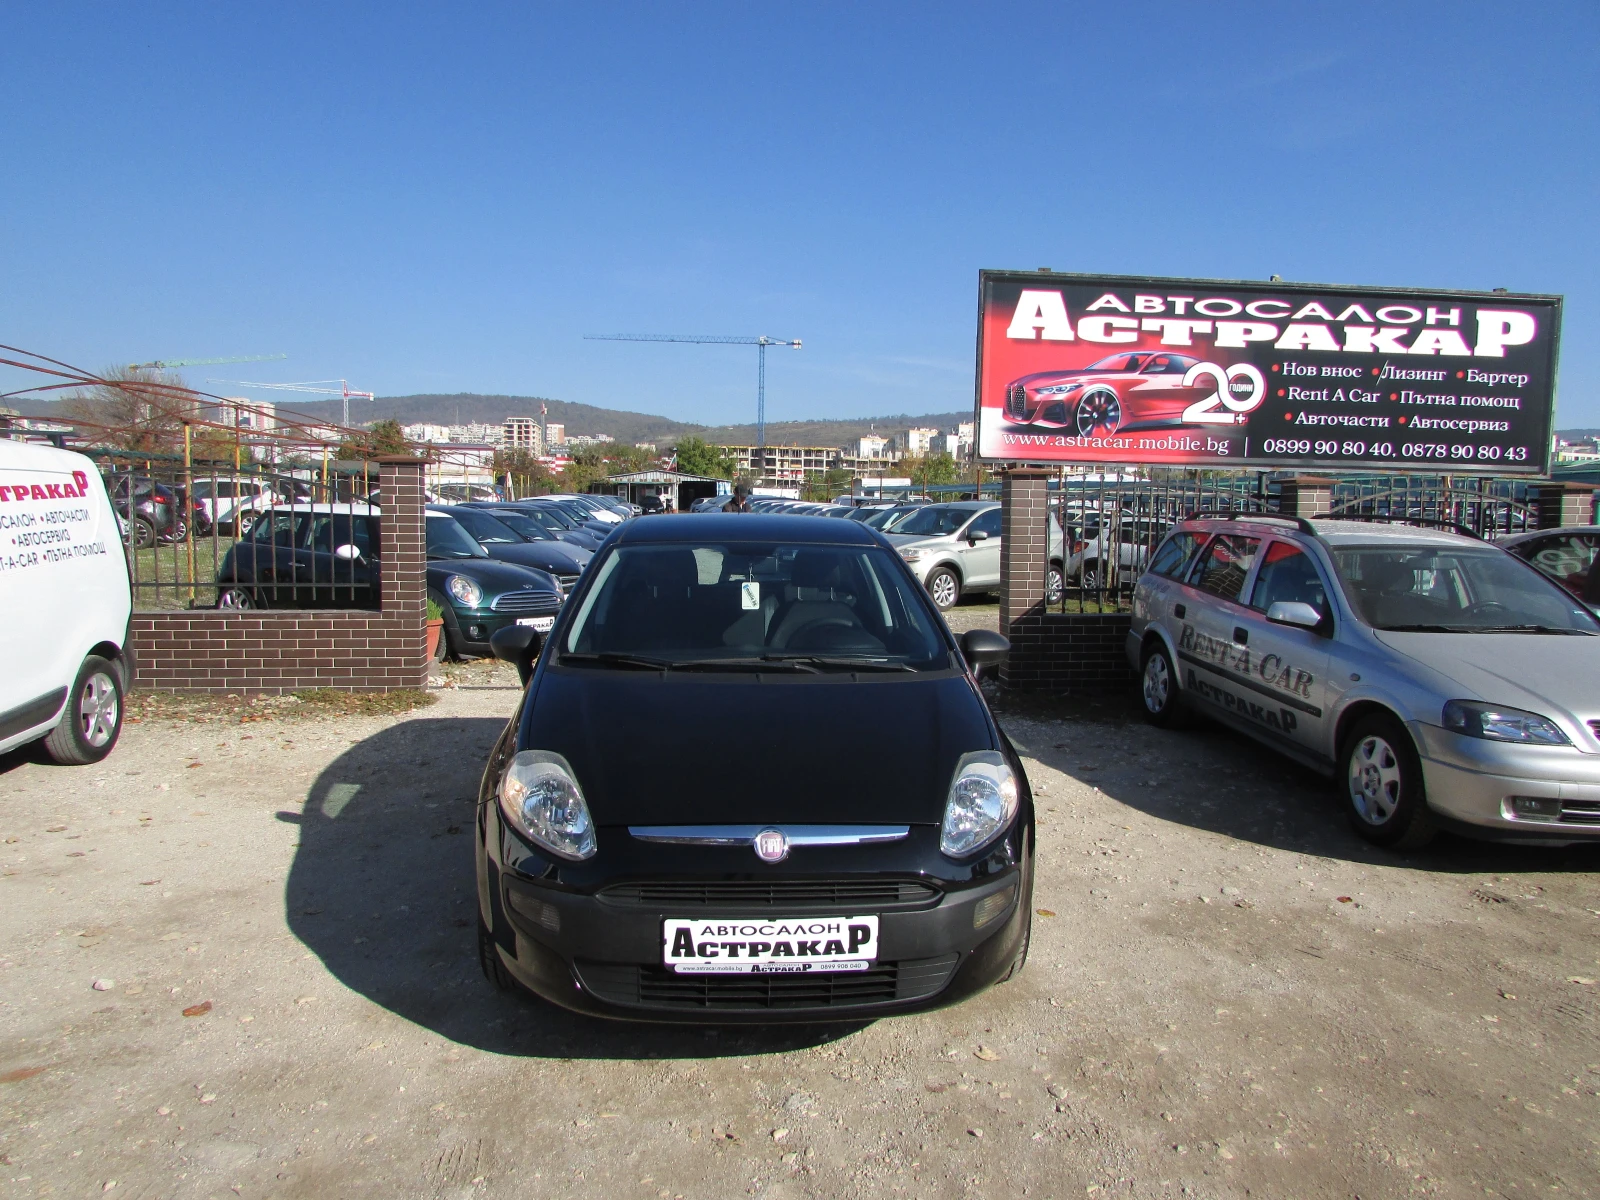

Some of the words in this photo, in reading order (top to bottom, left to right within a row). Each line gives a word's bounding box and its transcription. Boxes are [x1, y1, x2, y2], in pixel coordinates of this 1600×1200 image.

[1085, 294, 1461, 326] АВТОСАЛОН
[1006, 289, 1536, 357] АСТРАКАР
[1282, 363, 1317, 377] Нов
[1320, 366, 1362, 378] внос
[1379, 364, 1447, 383] Лизинг
[1466, 369, 1529, 388] Бартер
[1229, 383, 1254, 393] ГОДИНИ
[1287, 387, 1329, 402] Rent
[1332, 388, 1347, 402] A
[1349, 389, 1381, 403] Car
[1400, 391, 1457, 406] Пътна
[1460, 396, 1520, 410] помощ
[1294, 412, 1391, 428] Авточасти
[1408, 416, 1509, 433] Автосервиз
[1002, 433, 1229, 455] www.astracar.mobile.bg
[1263, 439, 1310, 454] 0899
[1314, 441, 1338, 455] 90
[1341, 441, 1365, 456] 80
[1369, 442, 1396, 458] 40,
[1402, 443, 1447, 457] 0878
[1450, 445, 1474, 459] 90
[1477, 446, 1501, 459] 80
[1503, 446, 1527, 460] 43
[0, 513, 37, 529] САЛОН
[45, 509, 91, 524] АВТОЧАСТИ
[17, 529, 71, 547] АВТОСЕРВИЗ
[46, 546, 73, 563] ПЪТНА
[1187, 669, 1298, 734] АСТРАКАР
[762, 838, 781, 853] FIAT
[700, 924, 841, 936] АВТОСАЛОН
[671, 924, 871, 957] АСТРАКАР
[750, 963, 813, 973] АСТРАКАР
